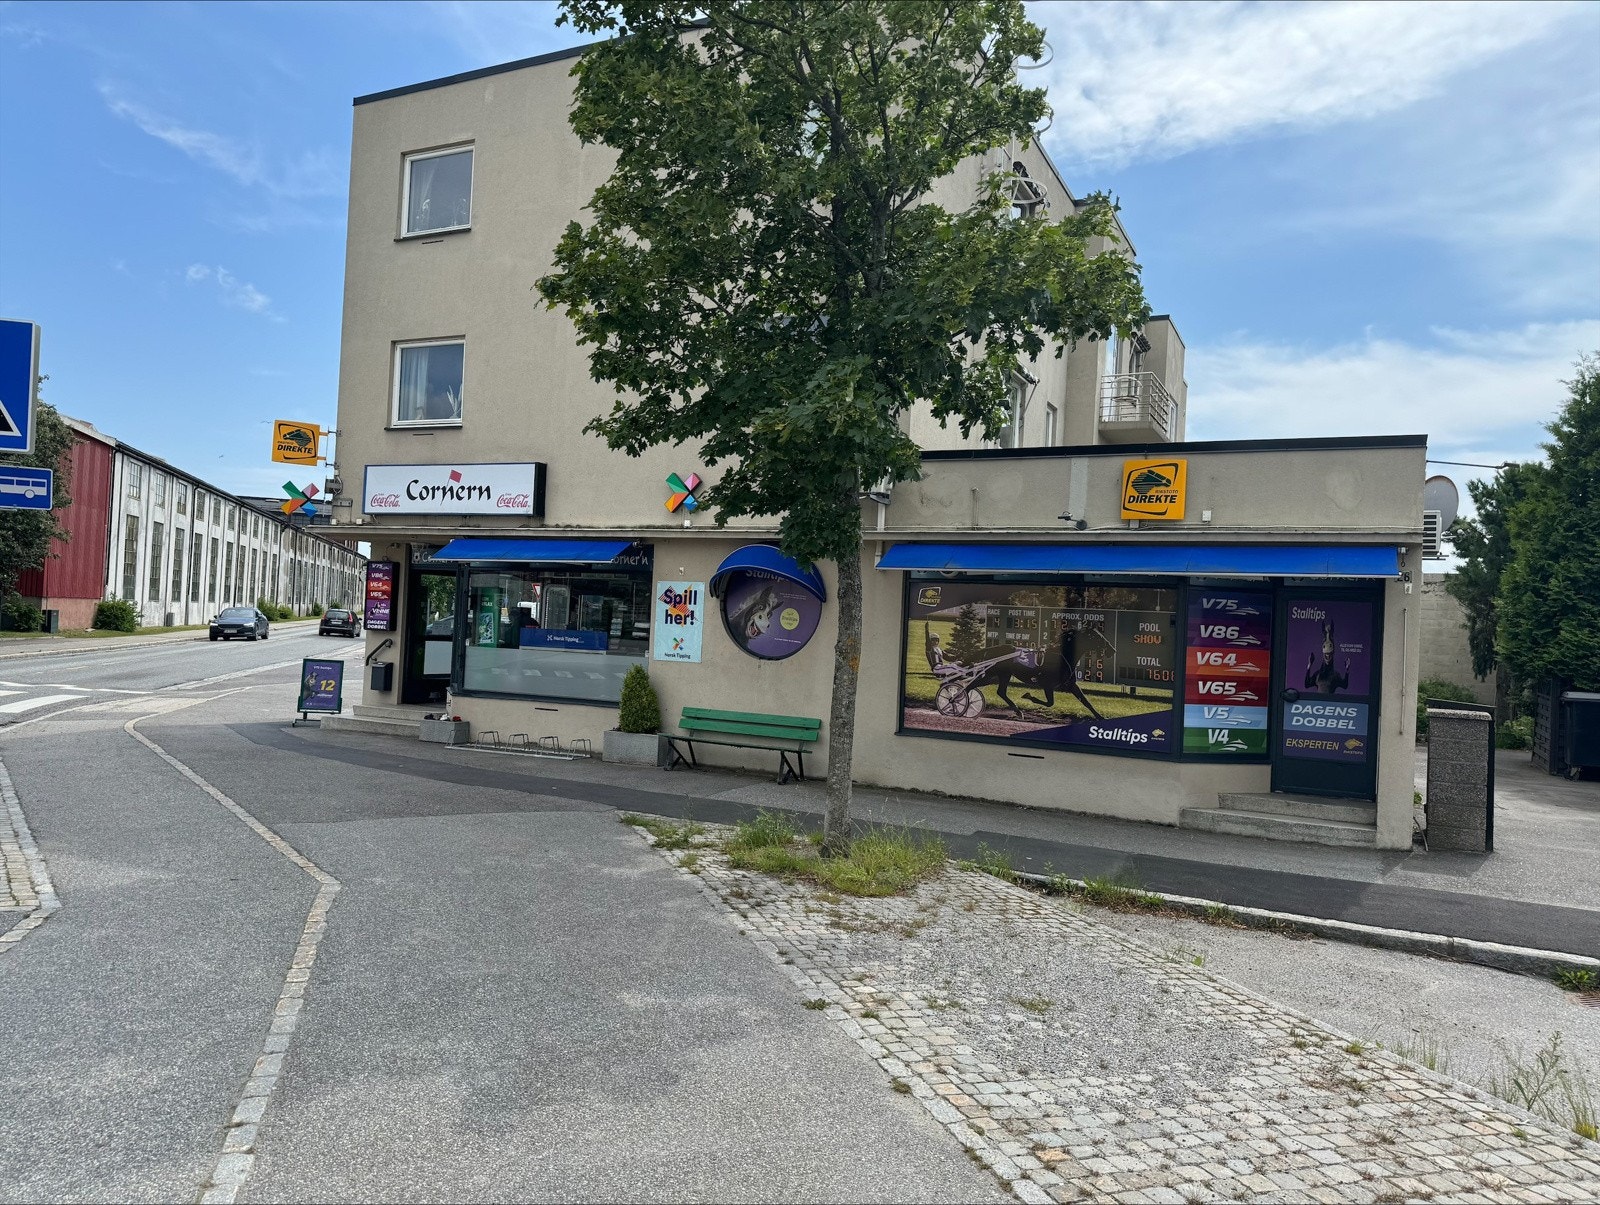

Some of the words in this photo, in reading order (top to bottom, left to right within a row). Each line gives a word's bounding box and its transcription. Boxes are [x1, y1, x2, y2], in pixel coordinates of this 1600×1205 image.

[277, 444, 313, 455] DIREKTE
[406, 479, 491, 502] Cornern
[1128, 495, 1178, 503] DIREKTE
[664, 589, 698, 608] Spill
[1202, 598, 1239, 611] V75
[664, 608, 695, 626] her!
[1292, 606, 1326, 622] Stalltips
[1139, 623, 1161, 632] POOL
[1200, 624, 1240, 639] V86
[1134, 635, 1162, 644] SHOW
[1136, 656, 1161, 667] TOTAL
[1196, 652, 1237, 667] V64
[320, 680, 336, 691] 12
[1198, 681, 1237, 695] V65
[1203, 706, 1230, 720] V5
[1291, 704, 1358, 717] DAGENS
[1291, 716, 1356, 730] DOBBEL
[1088, 726, 1148, 745] Stalltips
[1207, 728, 1230, 744] V4
[1285, 738, 1340, 751] EKSPERTEN
